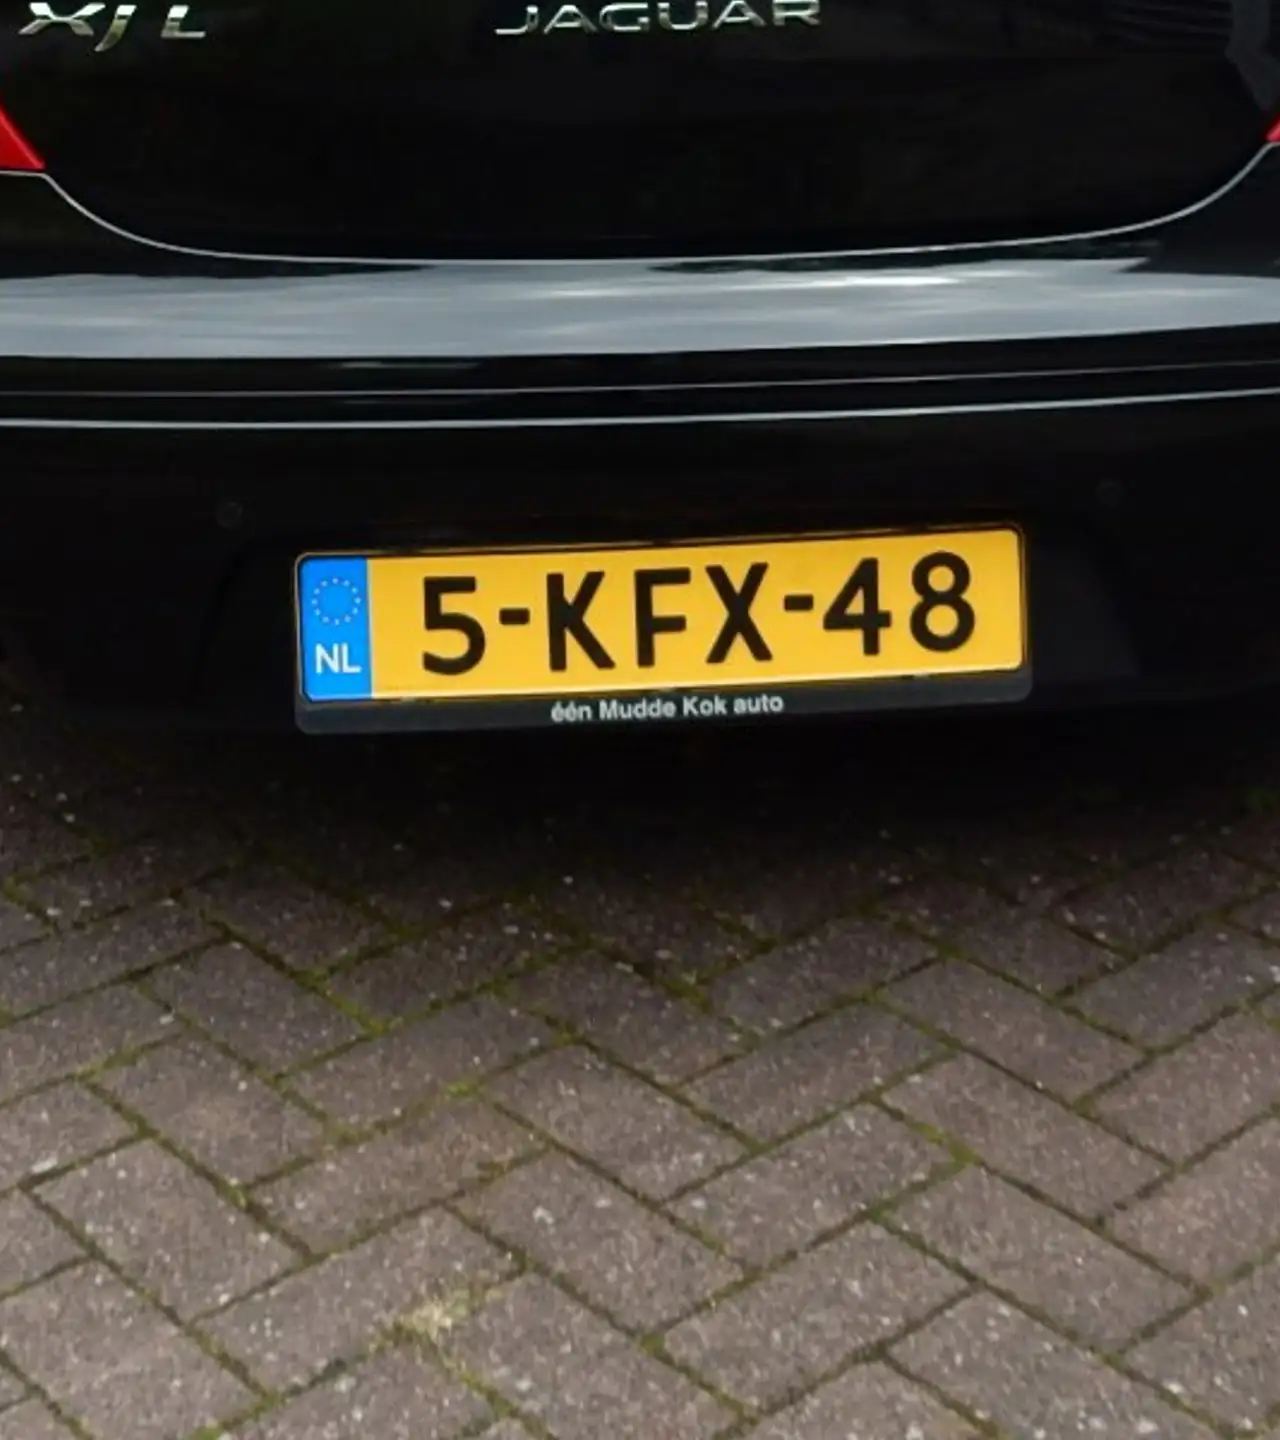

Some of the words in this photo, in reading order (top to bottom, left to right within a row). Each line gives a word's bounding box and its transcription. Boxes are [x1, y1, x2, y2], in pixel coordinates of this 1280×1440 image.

[421, 551, 976, 675] 5-KFX-48
[315, 642, 362, 673] NL
[550, 700, 592, 723] één
[599, 697, 676, 720] Mudde
[683, 694, 727, 716] Kok
[733, 693, 785, 714] auto
